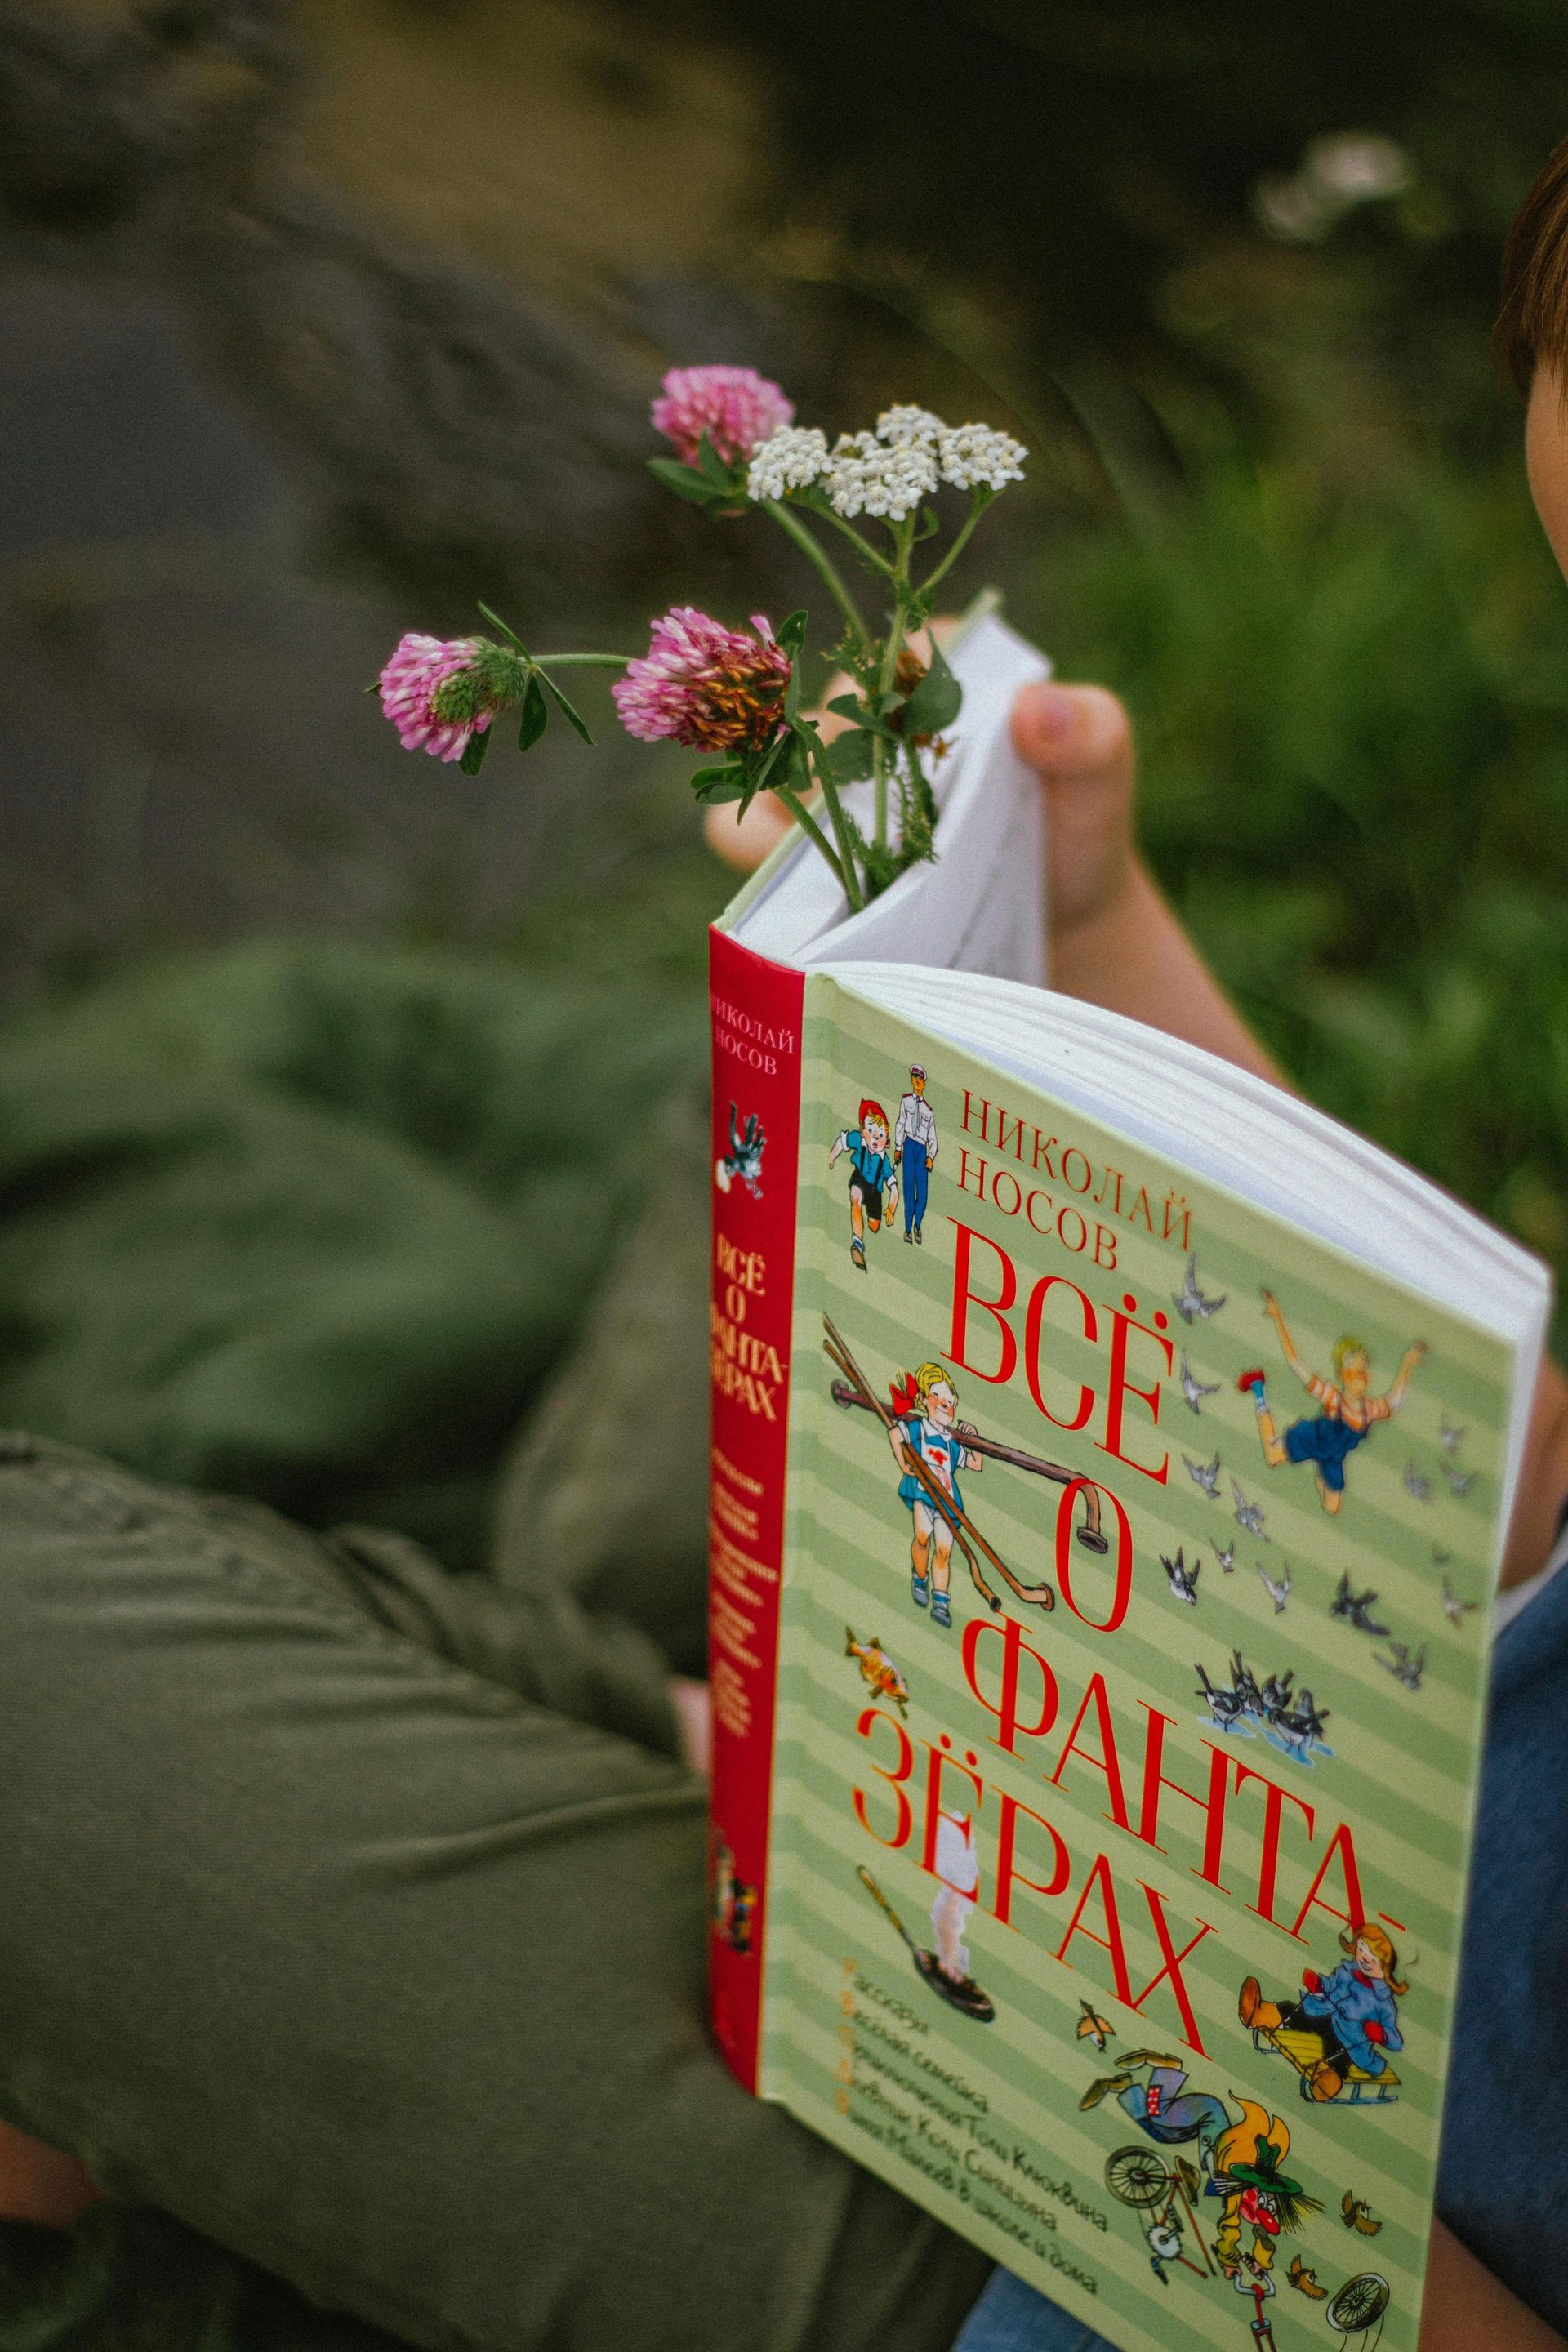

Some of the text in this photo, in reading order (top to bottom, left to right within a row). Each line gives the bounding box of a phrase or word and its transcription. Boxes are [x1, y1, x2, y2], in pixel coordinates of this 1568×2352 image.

[715, 1026, 777, 1075] НОСОВ
[956, 1147, 1117, 1271] НОСОВ
[960, 1088, 1192, 1251] НИКОЛАЙ
[711, 1302, 787, 1384] НТА-
[725, 1285, 746, 1324] О
[940, 1216, 1174, 1486] ВСЁ
[711, 1348, 777, 1422] РАХ
[1055, 1477, 1133, 1633] О
[961, 1609, 1405, 1945] ФАНТА-
[851, 1708, 1218, 2061] ЗЁРАХ
[1011, 2145, 1108, 2233] Клюквина
